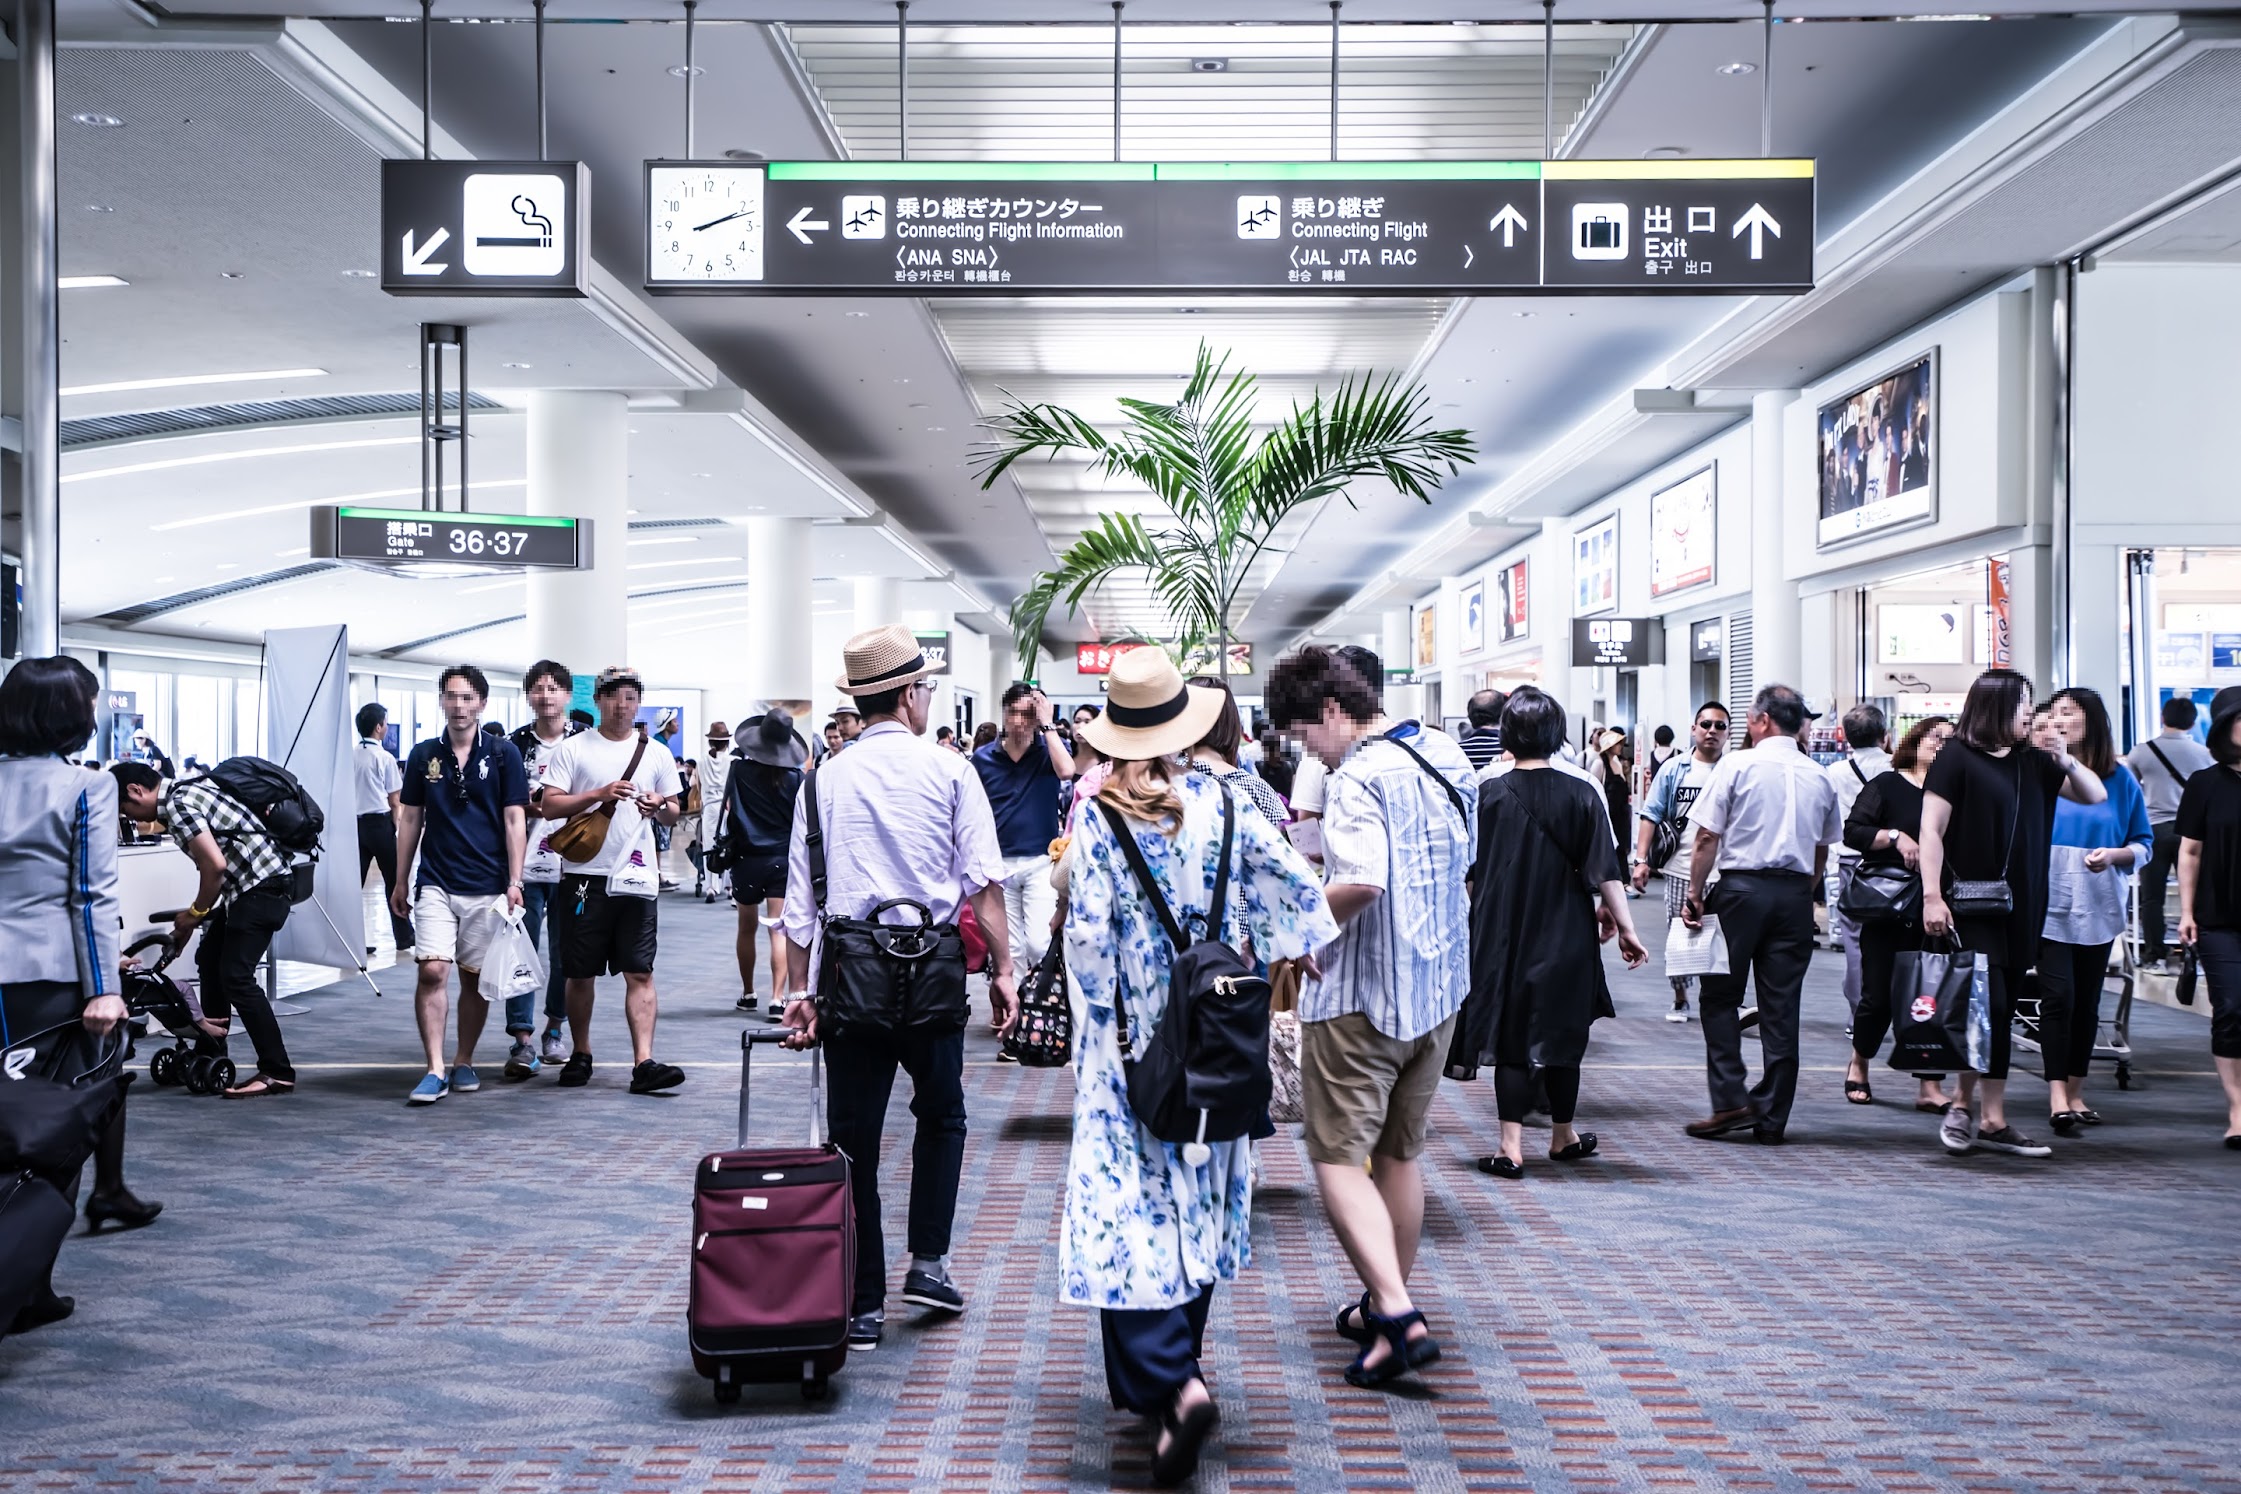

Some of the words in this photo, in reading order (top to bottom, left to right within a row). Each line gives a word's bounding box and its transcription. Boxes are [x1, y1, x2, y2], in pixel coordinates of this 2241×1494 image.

[685, 186, 694, 198] 11
[704, 181, 715, 192] 12
[670, 200, 680, 212] 10
[740, 200, 747, 212] 2
[896, 197, 1103, 219] 乗り継ぎカウンター
[1291, 196, 1385, 219] 乗り継ぎ
[664, 220, 673, 232] 9
[746, 220, 753, 232] 3
[896, 222, 985, 242] Connecting
[989, 222, 1032, 242] Flight
[1037, 222, 1124, 239] Information
[1291, 221, 1380, 242] Connecting
[1384, 221, 1428, 242] Flight
[671, 241, 680, 253] 8
[738, 241, 746, 252] 4
[1644, 237, 1688, 258] Exit
[687, 254, 694, 266] 7
[725, 254, 733, 266] 5
[1339, 249, 1371, 266] JTA
[1381, 249, 1417, 266] RAC
[705, 260, 713, 272] 6
[1644, 260, 1674, 275] 출구
[1685, 260, 1712, 275] 出口
[1288, 270, 1312, 282] 환승
[1321, 270, 1346, 282] 轉機
[387, 535, 415, 548] Gate
